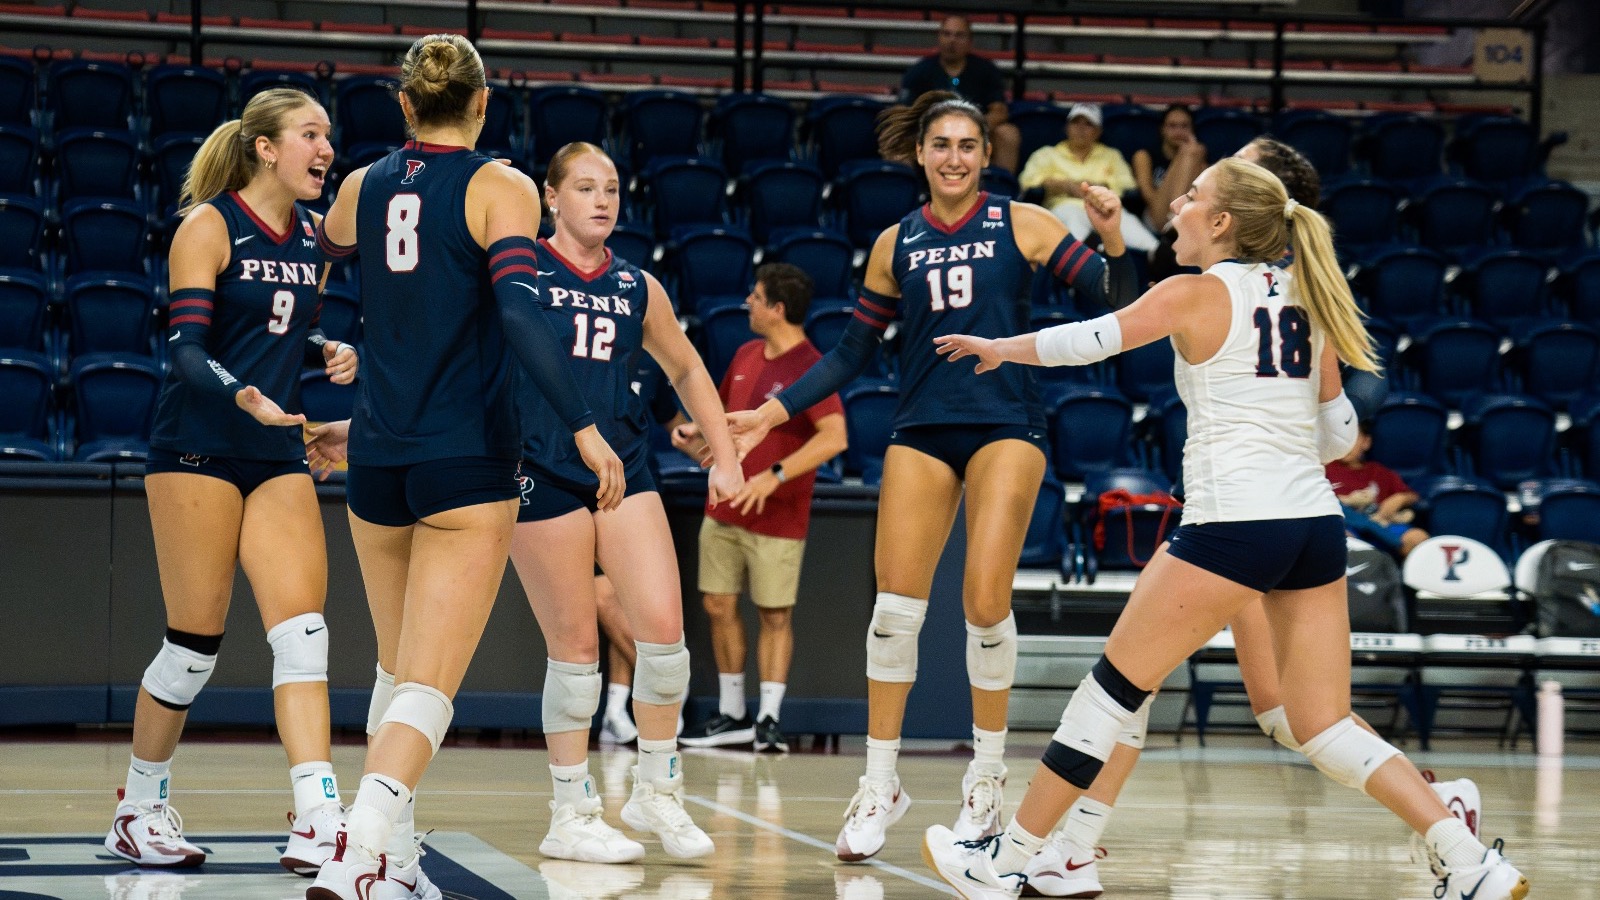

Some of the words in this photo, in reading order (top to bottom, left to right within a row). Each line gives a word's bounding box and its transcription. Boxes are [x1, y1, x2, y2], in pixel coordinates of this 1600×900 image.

[1484, 44, 1523, 64] 104
[385, 193, 422, 273] 8
[240, 259, 317, 286] PENN
[908, 241, 996, 271] PENN
[549, 287, 632, 316] PENN
[926, 265, 973, 312] 19
[268, 290, 295, 336] 9
[572, 313, 616, 362] 12
[1253, 305, 1312, 379] 18
[1439, 546, 1470, 581] P
